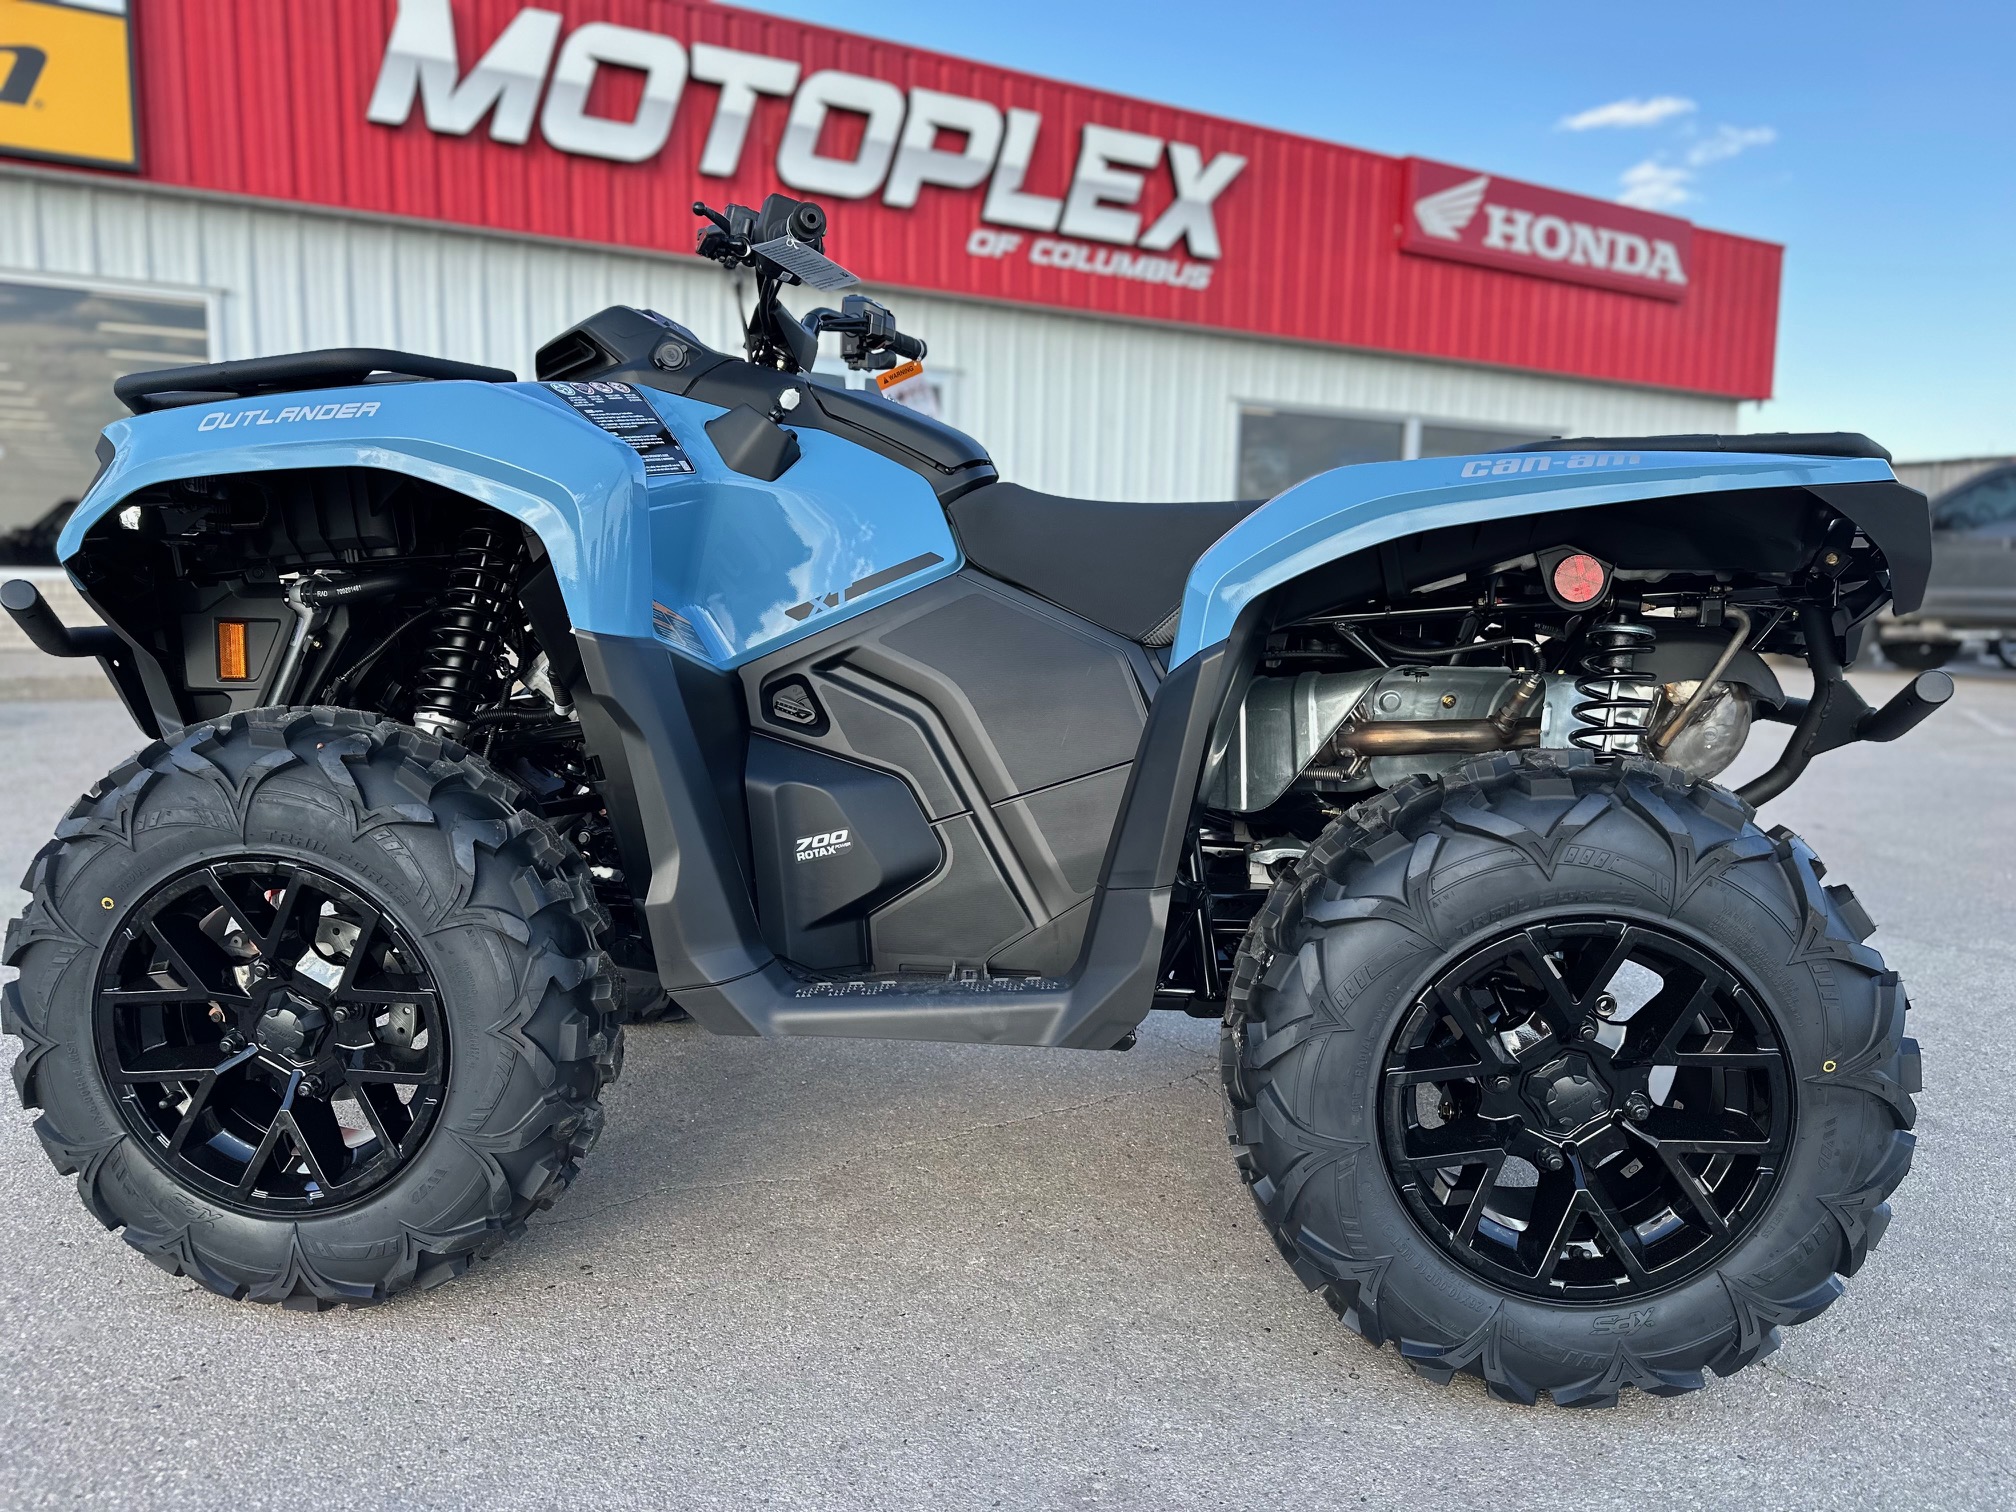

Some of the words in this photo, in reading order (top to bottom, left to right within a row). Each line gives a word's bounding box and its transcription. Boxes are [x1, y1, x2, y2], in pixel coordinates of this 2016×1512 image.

[367, 0, 1247, 259] MOTOPLEX
[966, 227, 1021, 259] OF
[1027, 239, 1215, 291] COLUMBUS
[1483, 204, 1687, 283] HONDA
[888, 365, 915, 382] WARNING
[197, 401, 381, 433] OUTLANDER
[1460, 453, 1641, 479] can-am
[807, 586, 851, 617] XT
[795, 829, 849, 852] 700
[795, 845, 837, 862] ROTAX
[835, 841, 852, 850] POWER
[1453, 895, 1530, 939] TRAIL
[1535, 887, 1637, 906] FORCE
[1589, 1304, 1661, 1340] XPS
